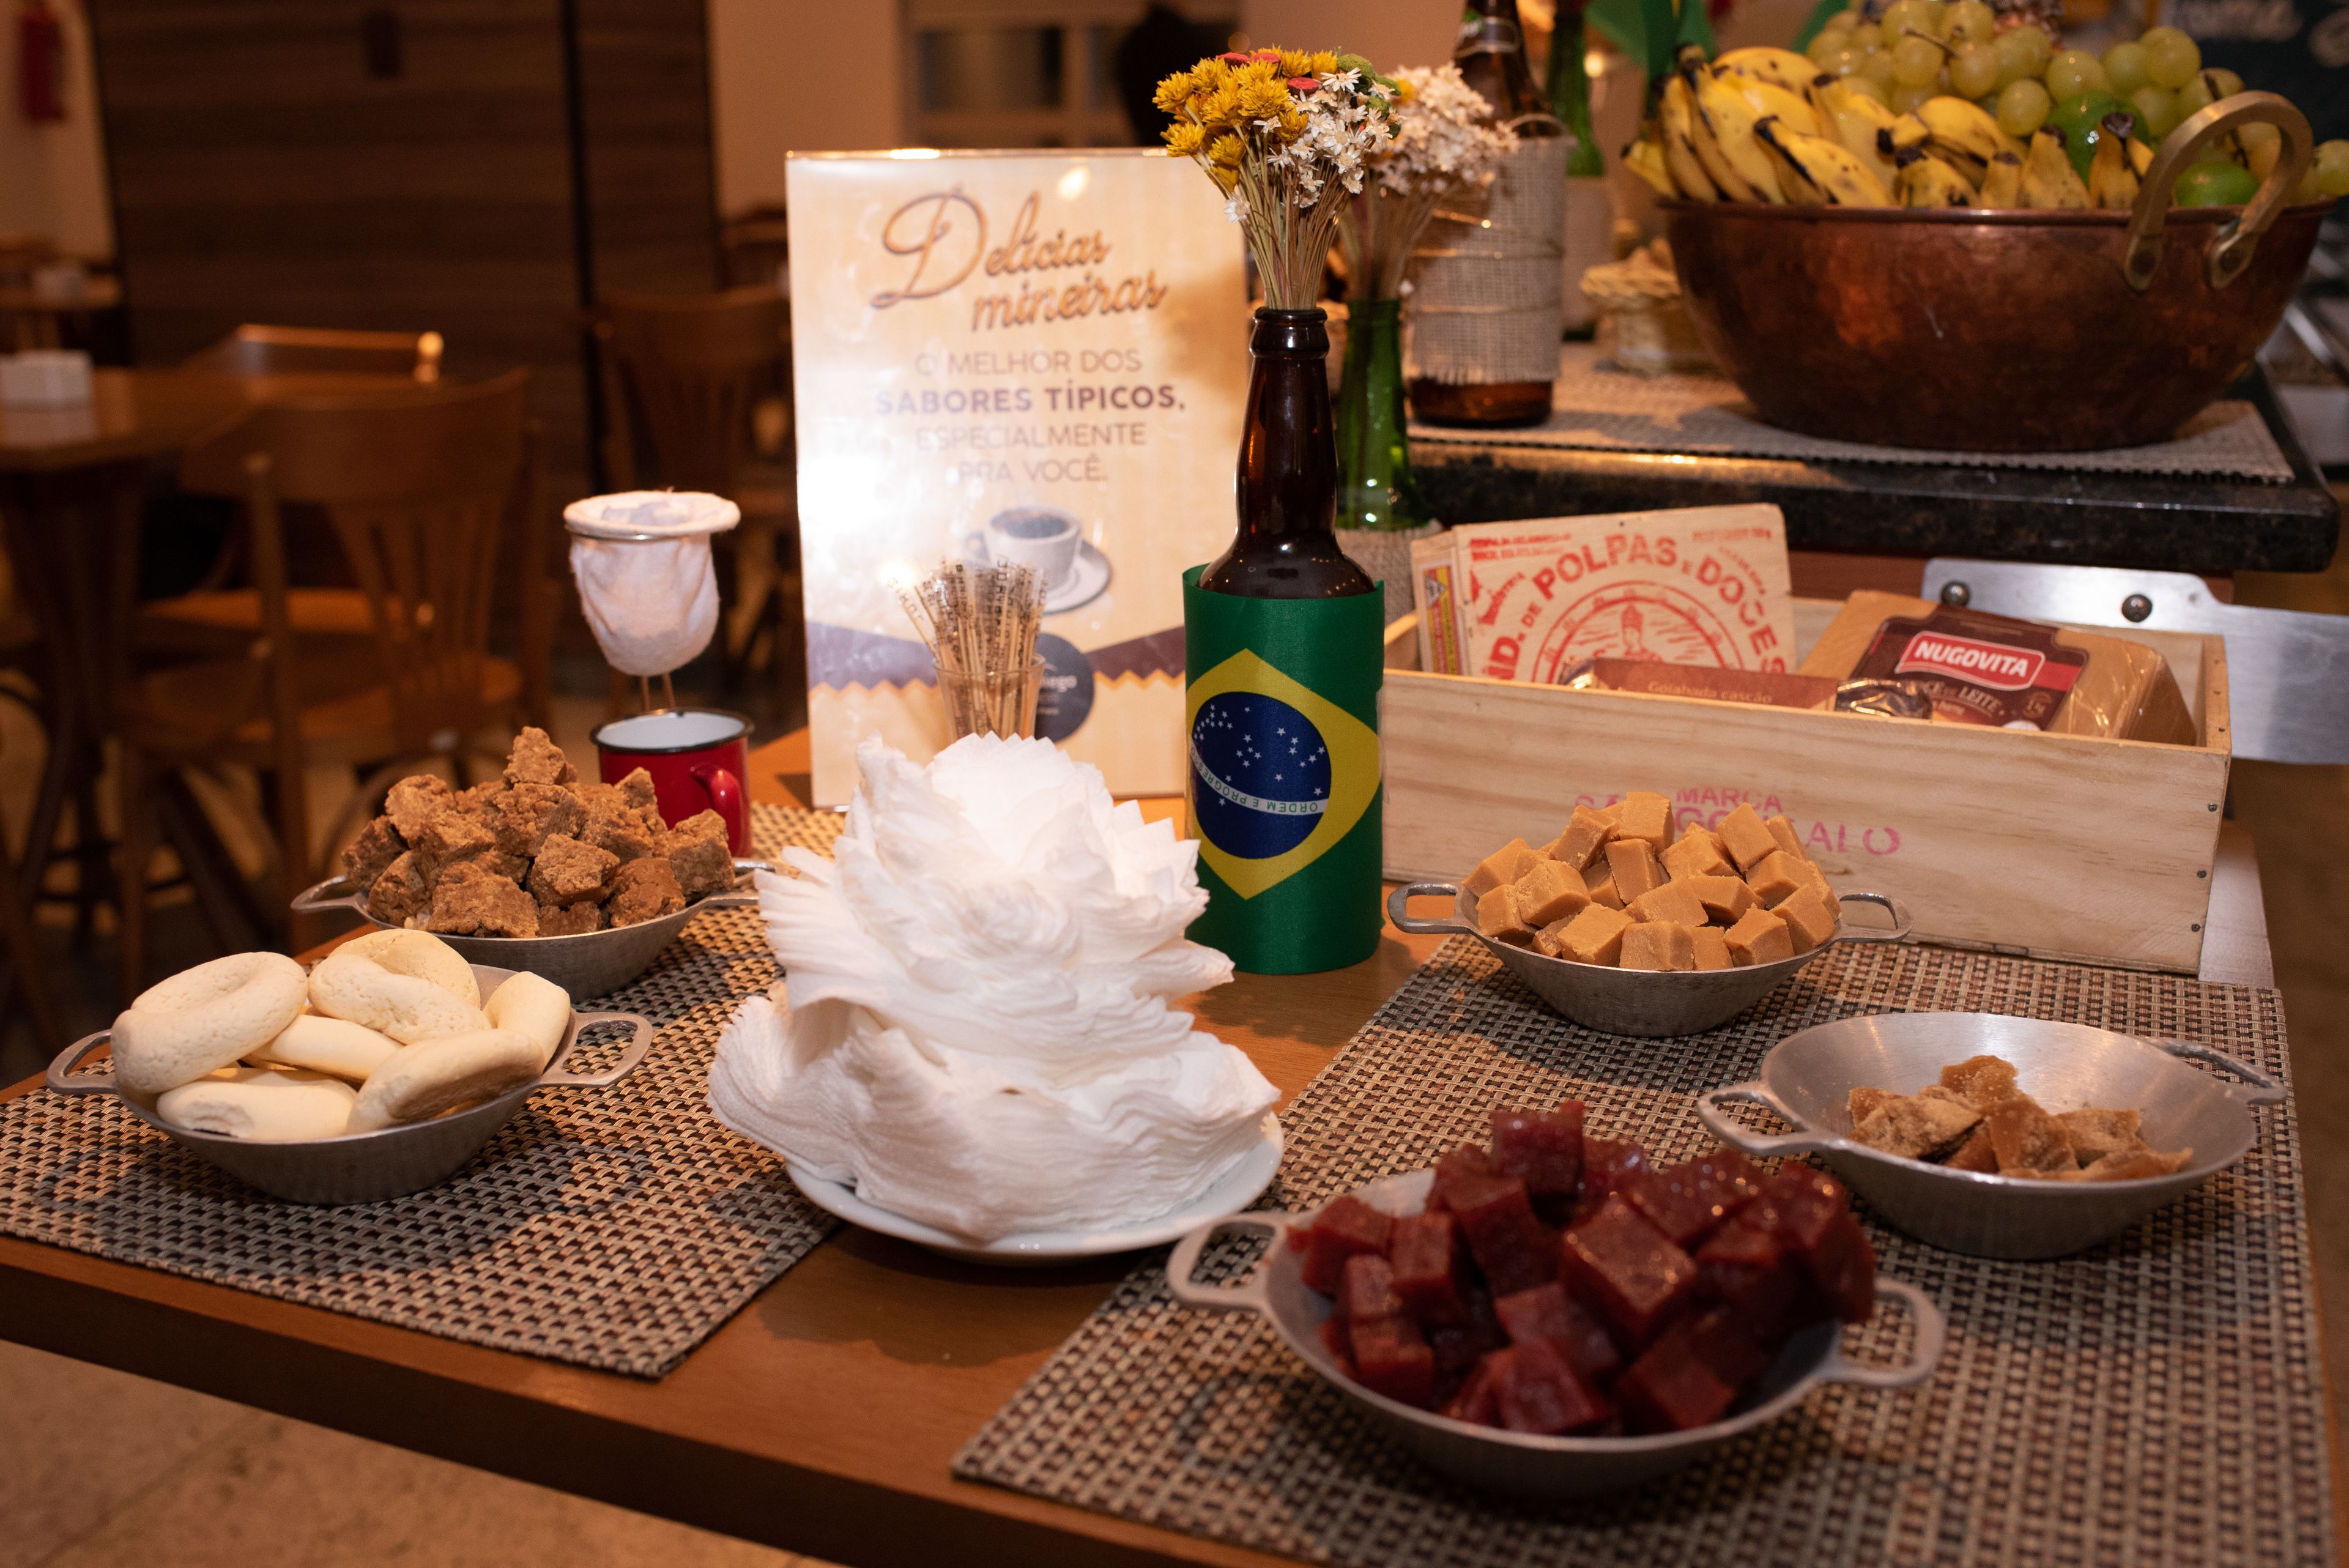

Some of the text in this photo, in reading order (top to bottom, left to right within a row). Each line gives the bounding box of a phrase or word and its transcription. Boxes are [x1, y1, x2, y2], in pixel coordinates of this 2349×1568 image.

[971, 269, 1168, 332] mineiras
[914, 349, 1143, 377] O MELHOR DOS
[875, 387, 1033, 415] SABORES
[915, 422, 1147, 451] ESPECIALMENTE
[1532, 533, 1678, 602] POLPAS
[1913, 640, 2029, 678] NUGOVITA
[1959, 686, 2004, 714] LEITE
[1252, 798, 1260, 808] E
[1266, 801, 1318, 813] ORDEM
[1676, 787, 1783, 813] MARCA
